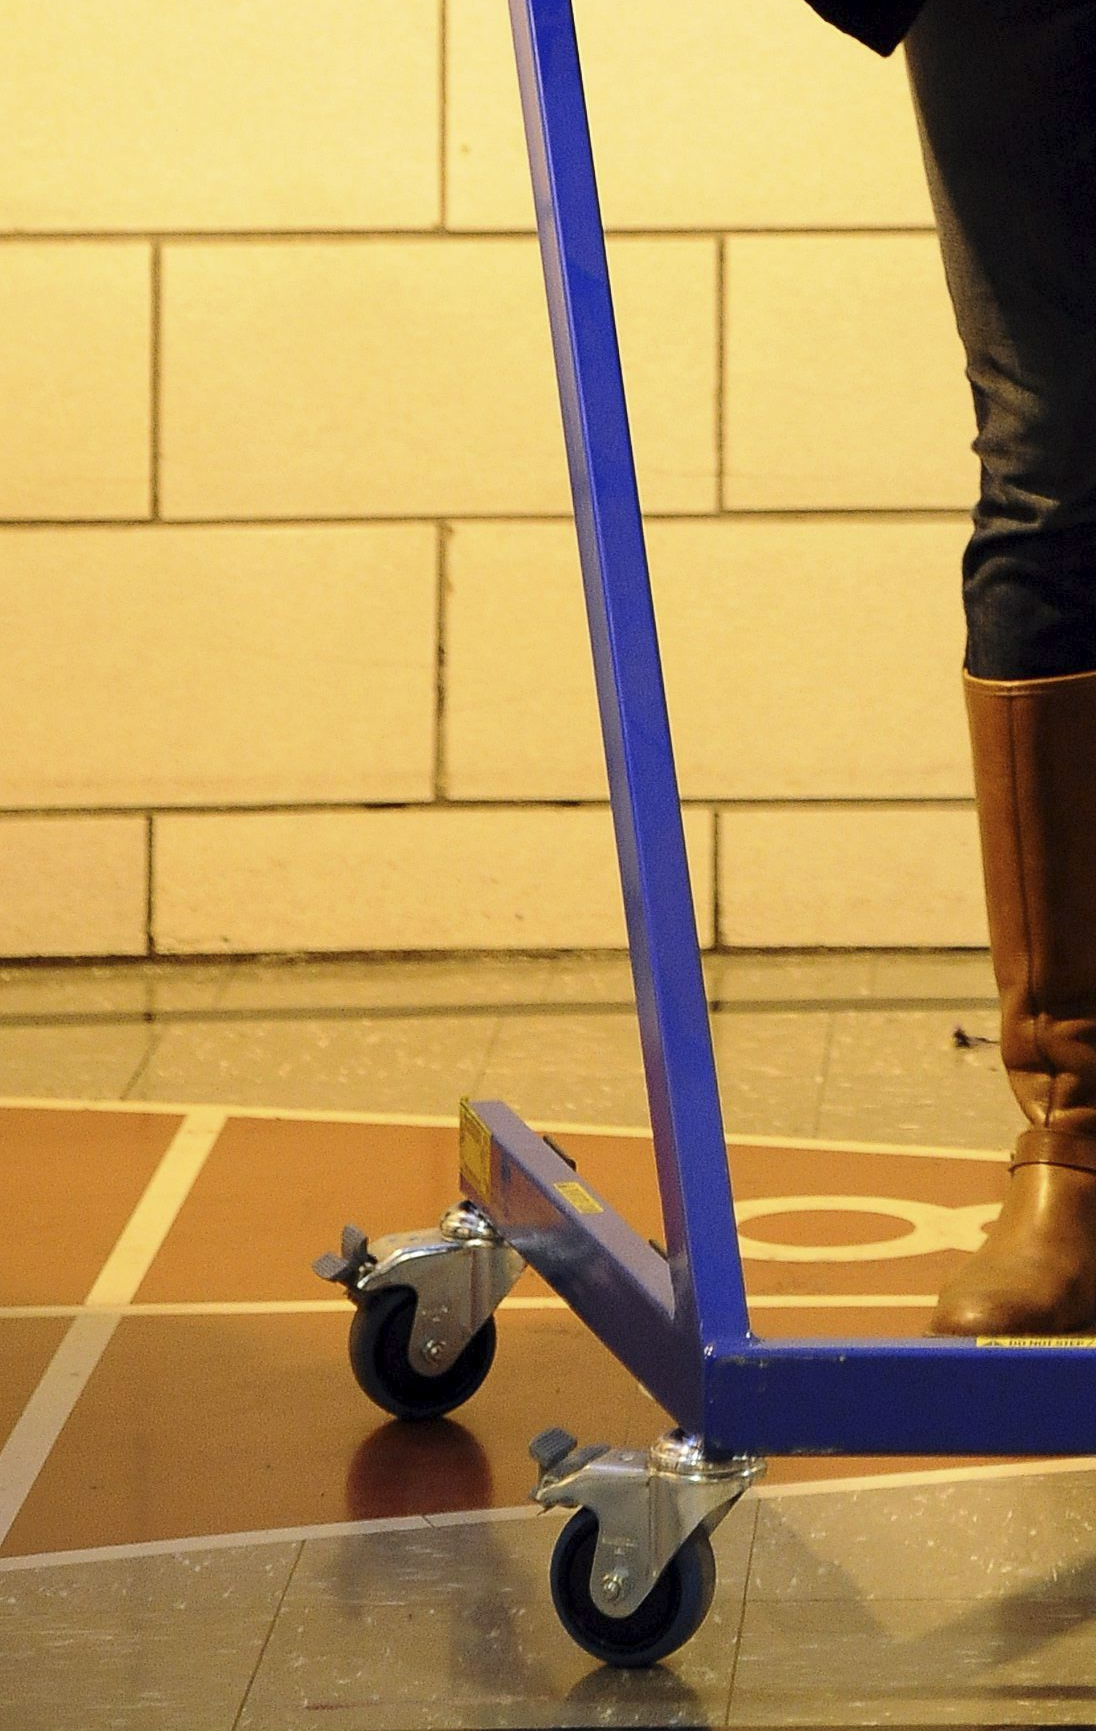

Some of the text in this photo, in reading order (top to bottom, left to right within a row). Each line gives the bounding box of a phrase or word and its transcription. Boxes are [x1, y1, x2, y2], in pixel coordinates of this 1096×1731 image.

[1009, 1339, 1027, 1347] DO
[1029, 1339, 1051, 1347] NOT
[1055, 1339, 1084, 1347] STEP
